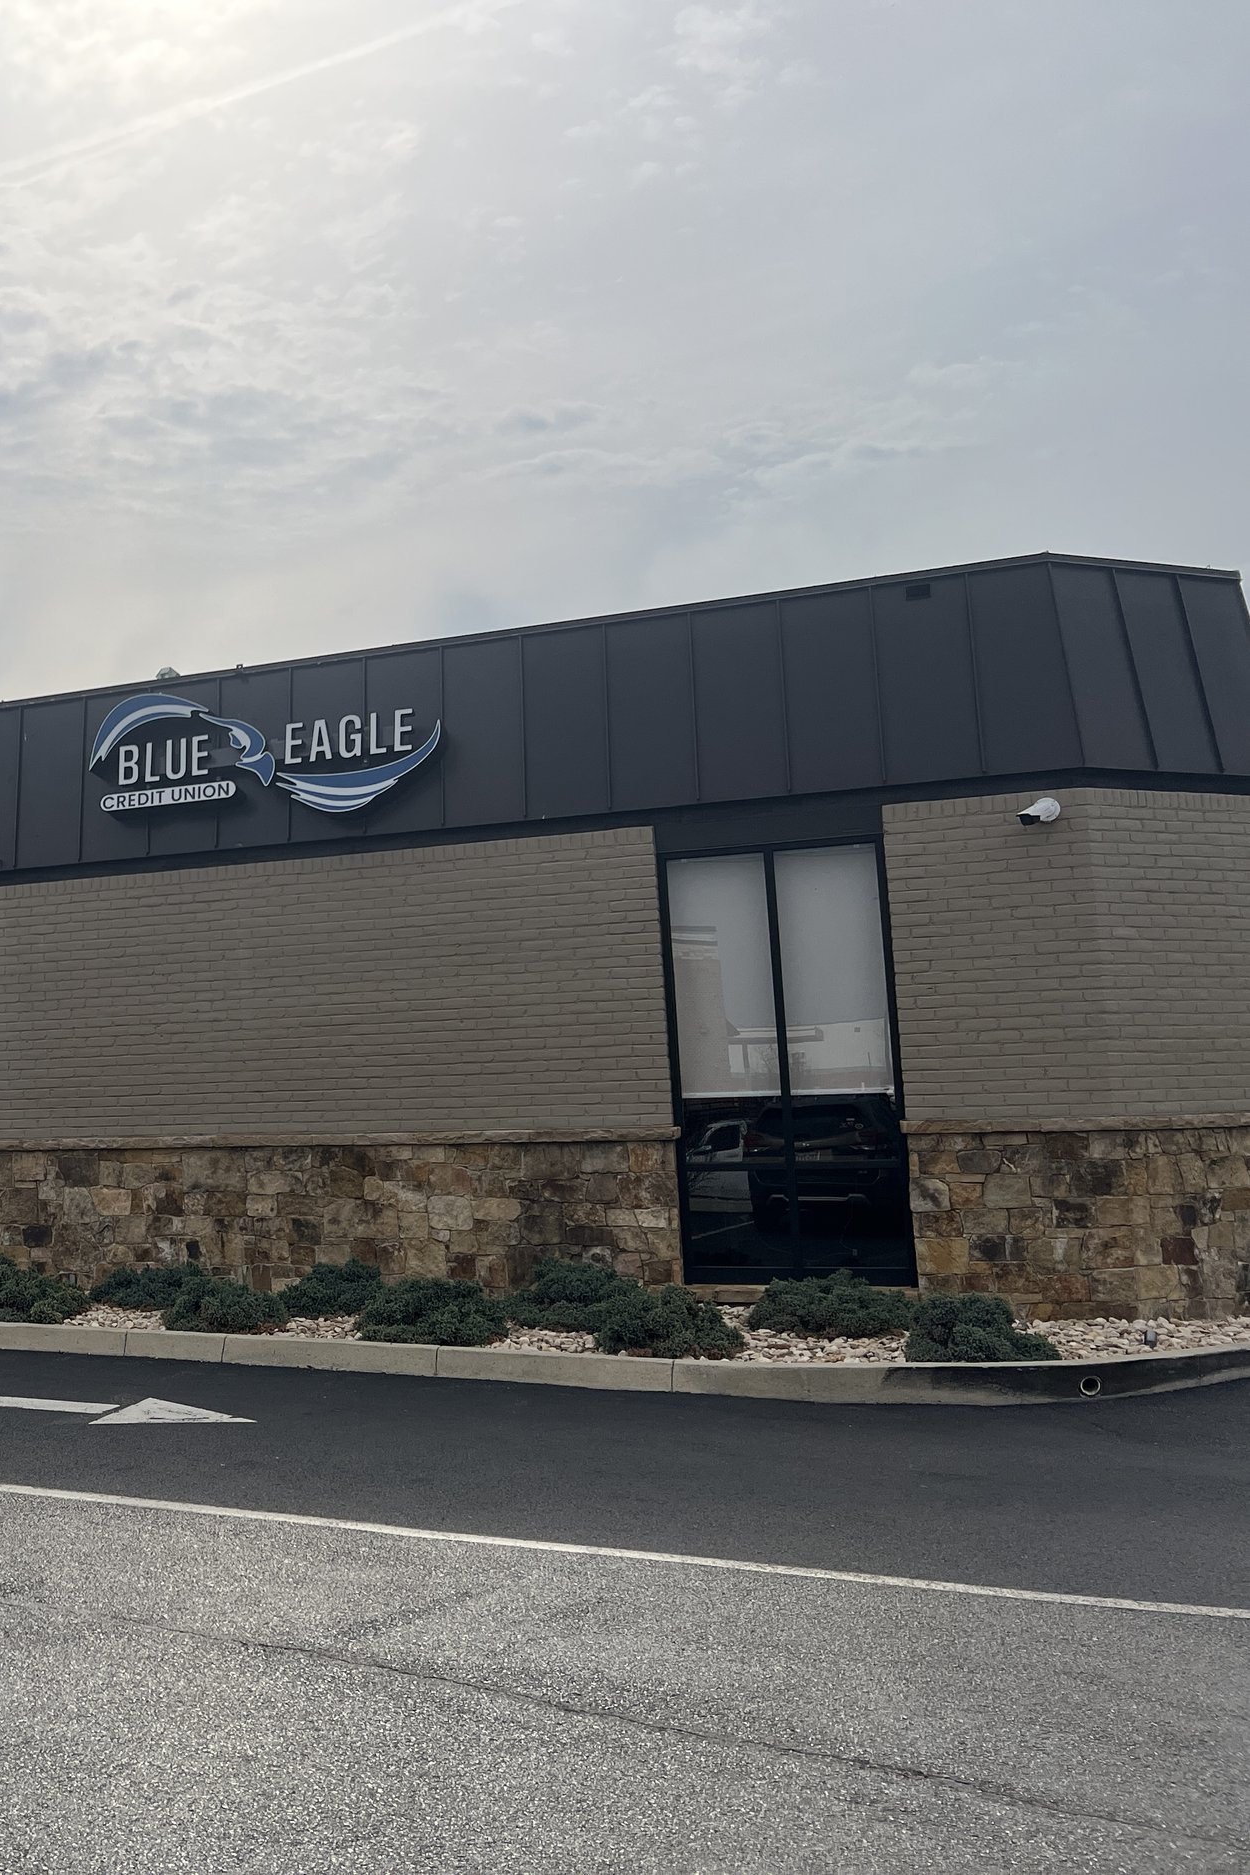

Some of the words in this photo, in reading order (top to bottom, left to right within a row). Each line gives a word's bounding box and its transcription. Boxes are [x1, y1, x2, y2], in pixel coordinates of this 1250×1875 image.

[118, 734, 209, 786] BLUE
[284, 708, 413, 764] EAGLE
[102, 790, 165, 810] CREDIT
[171, 782, 230, 801] UNION
